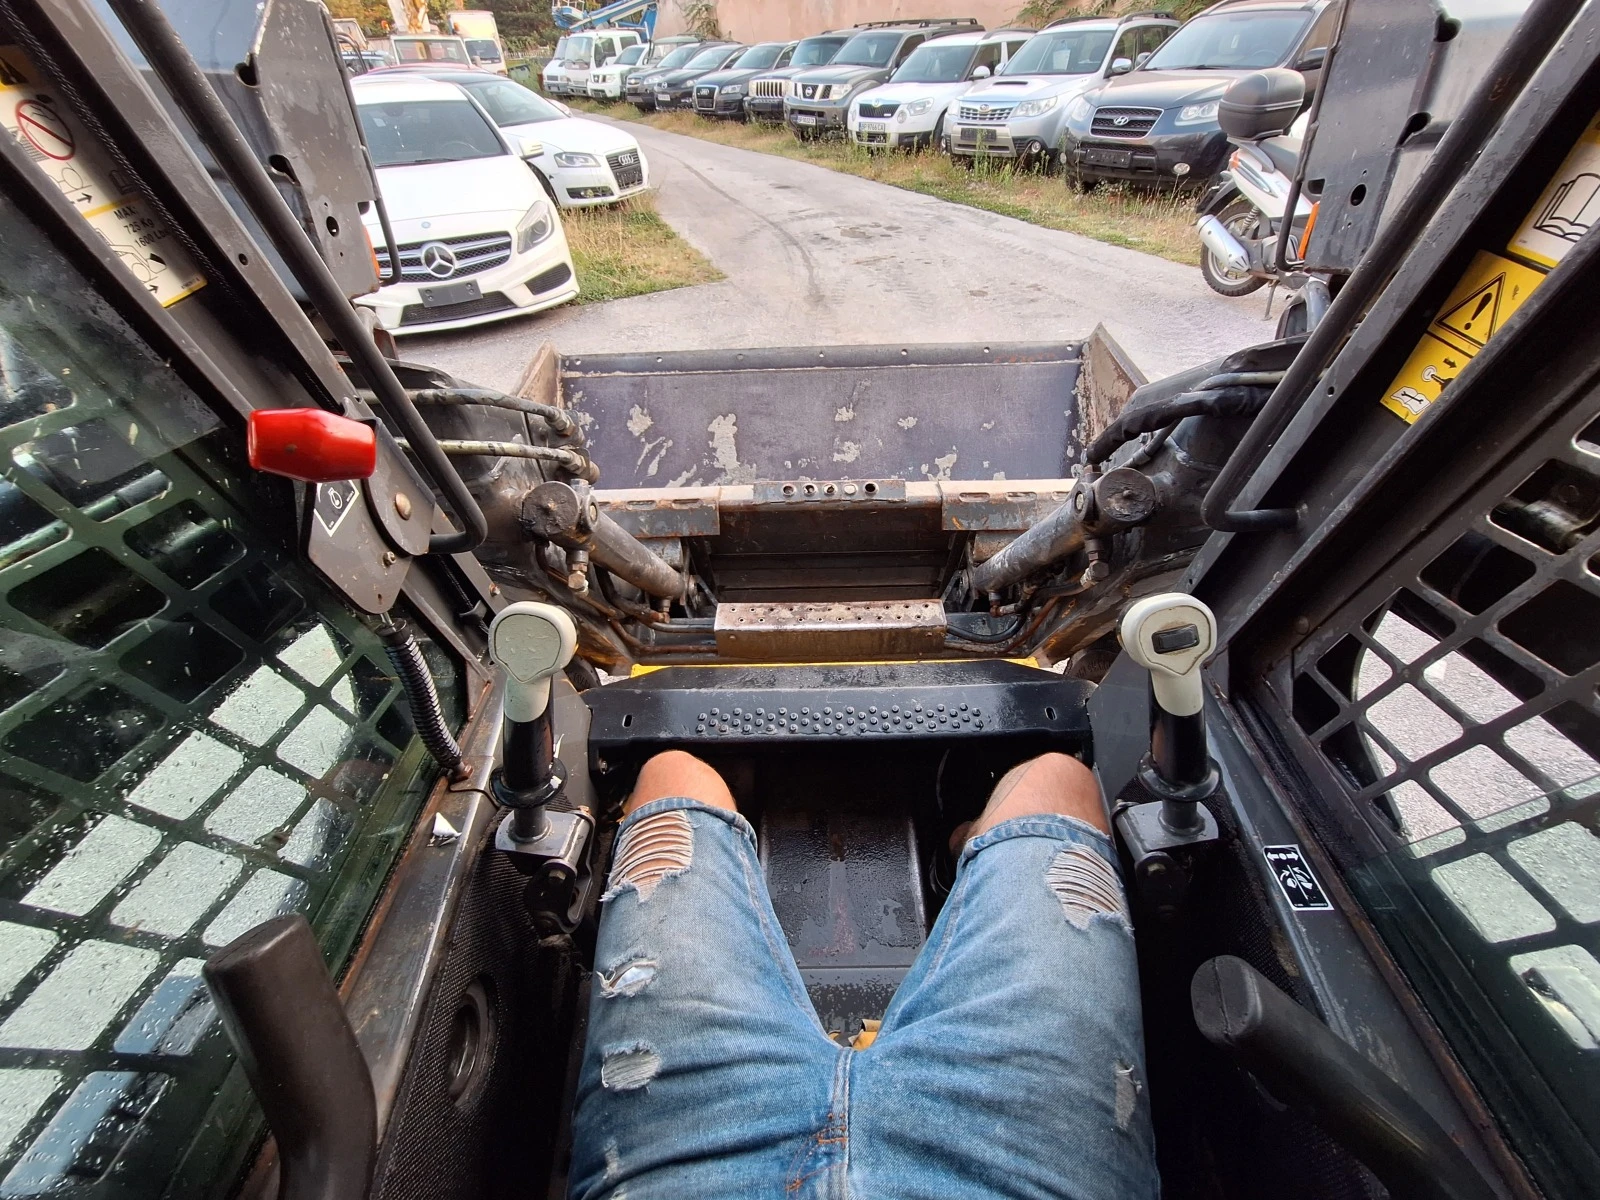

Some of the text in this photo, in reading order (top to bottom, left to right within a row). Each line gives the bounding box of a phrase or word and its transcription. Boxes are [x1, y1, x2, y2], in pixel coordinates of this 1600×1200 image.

[123, 218, 155, 235] 725 Kg
[135, 234, 155, 248] 1600
